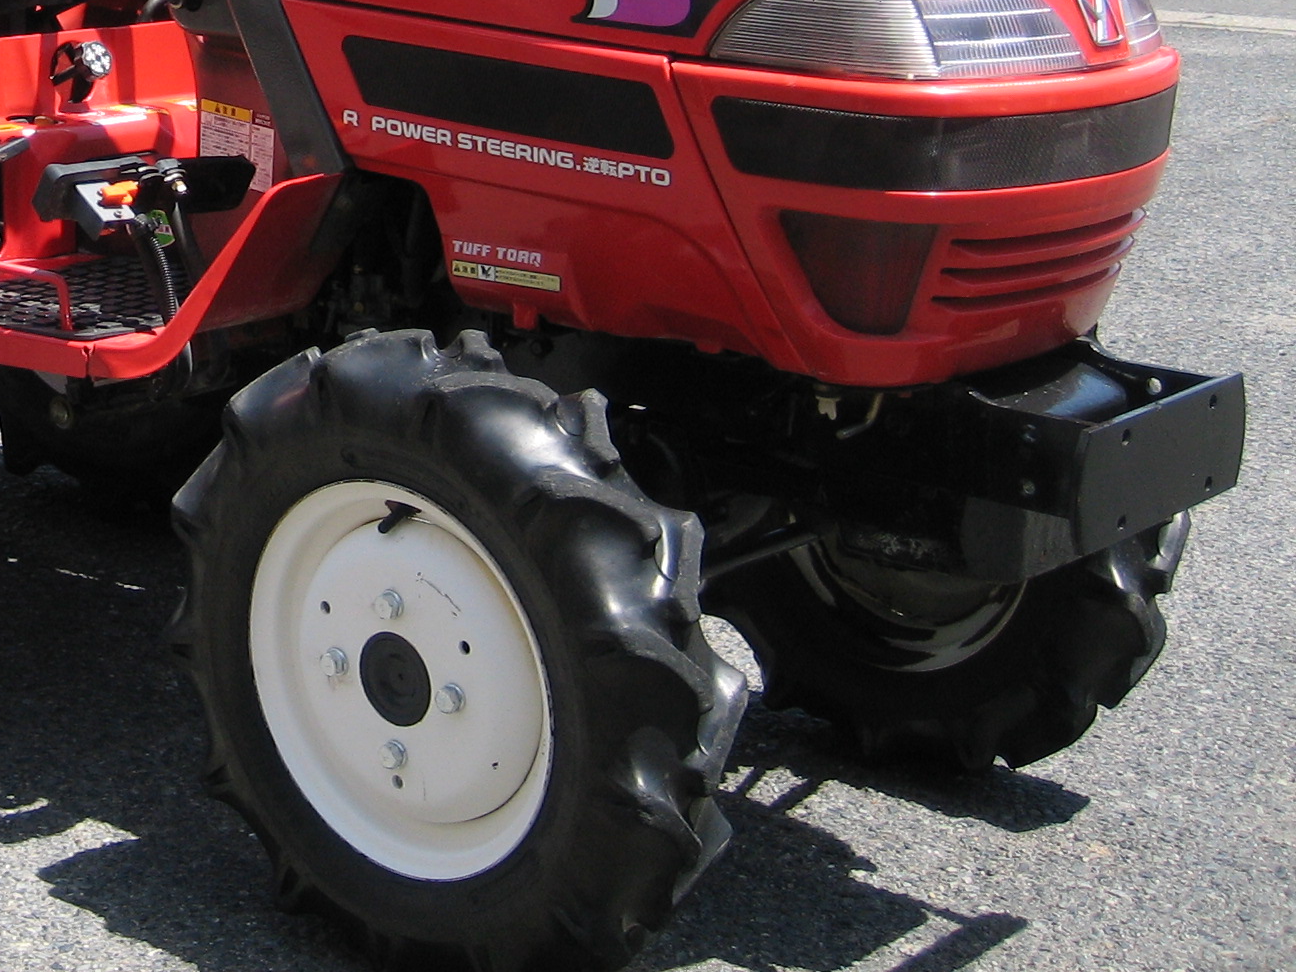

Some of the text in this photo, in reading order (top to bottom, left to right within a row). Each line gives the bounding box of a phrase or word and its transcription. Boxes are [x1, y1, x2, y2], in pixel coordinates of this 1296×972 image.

[342, 109, 359, 127] R
[371, 115, 452, 147] POWER
[452, 239, 542, 268] TUFF TORQ
